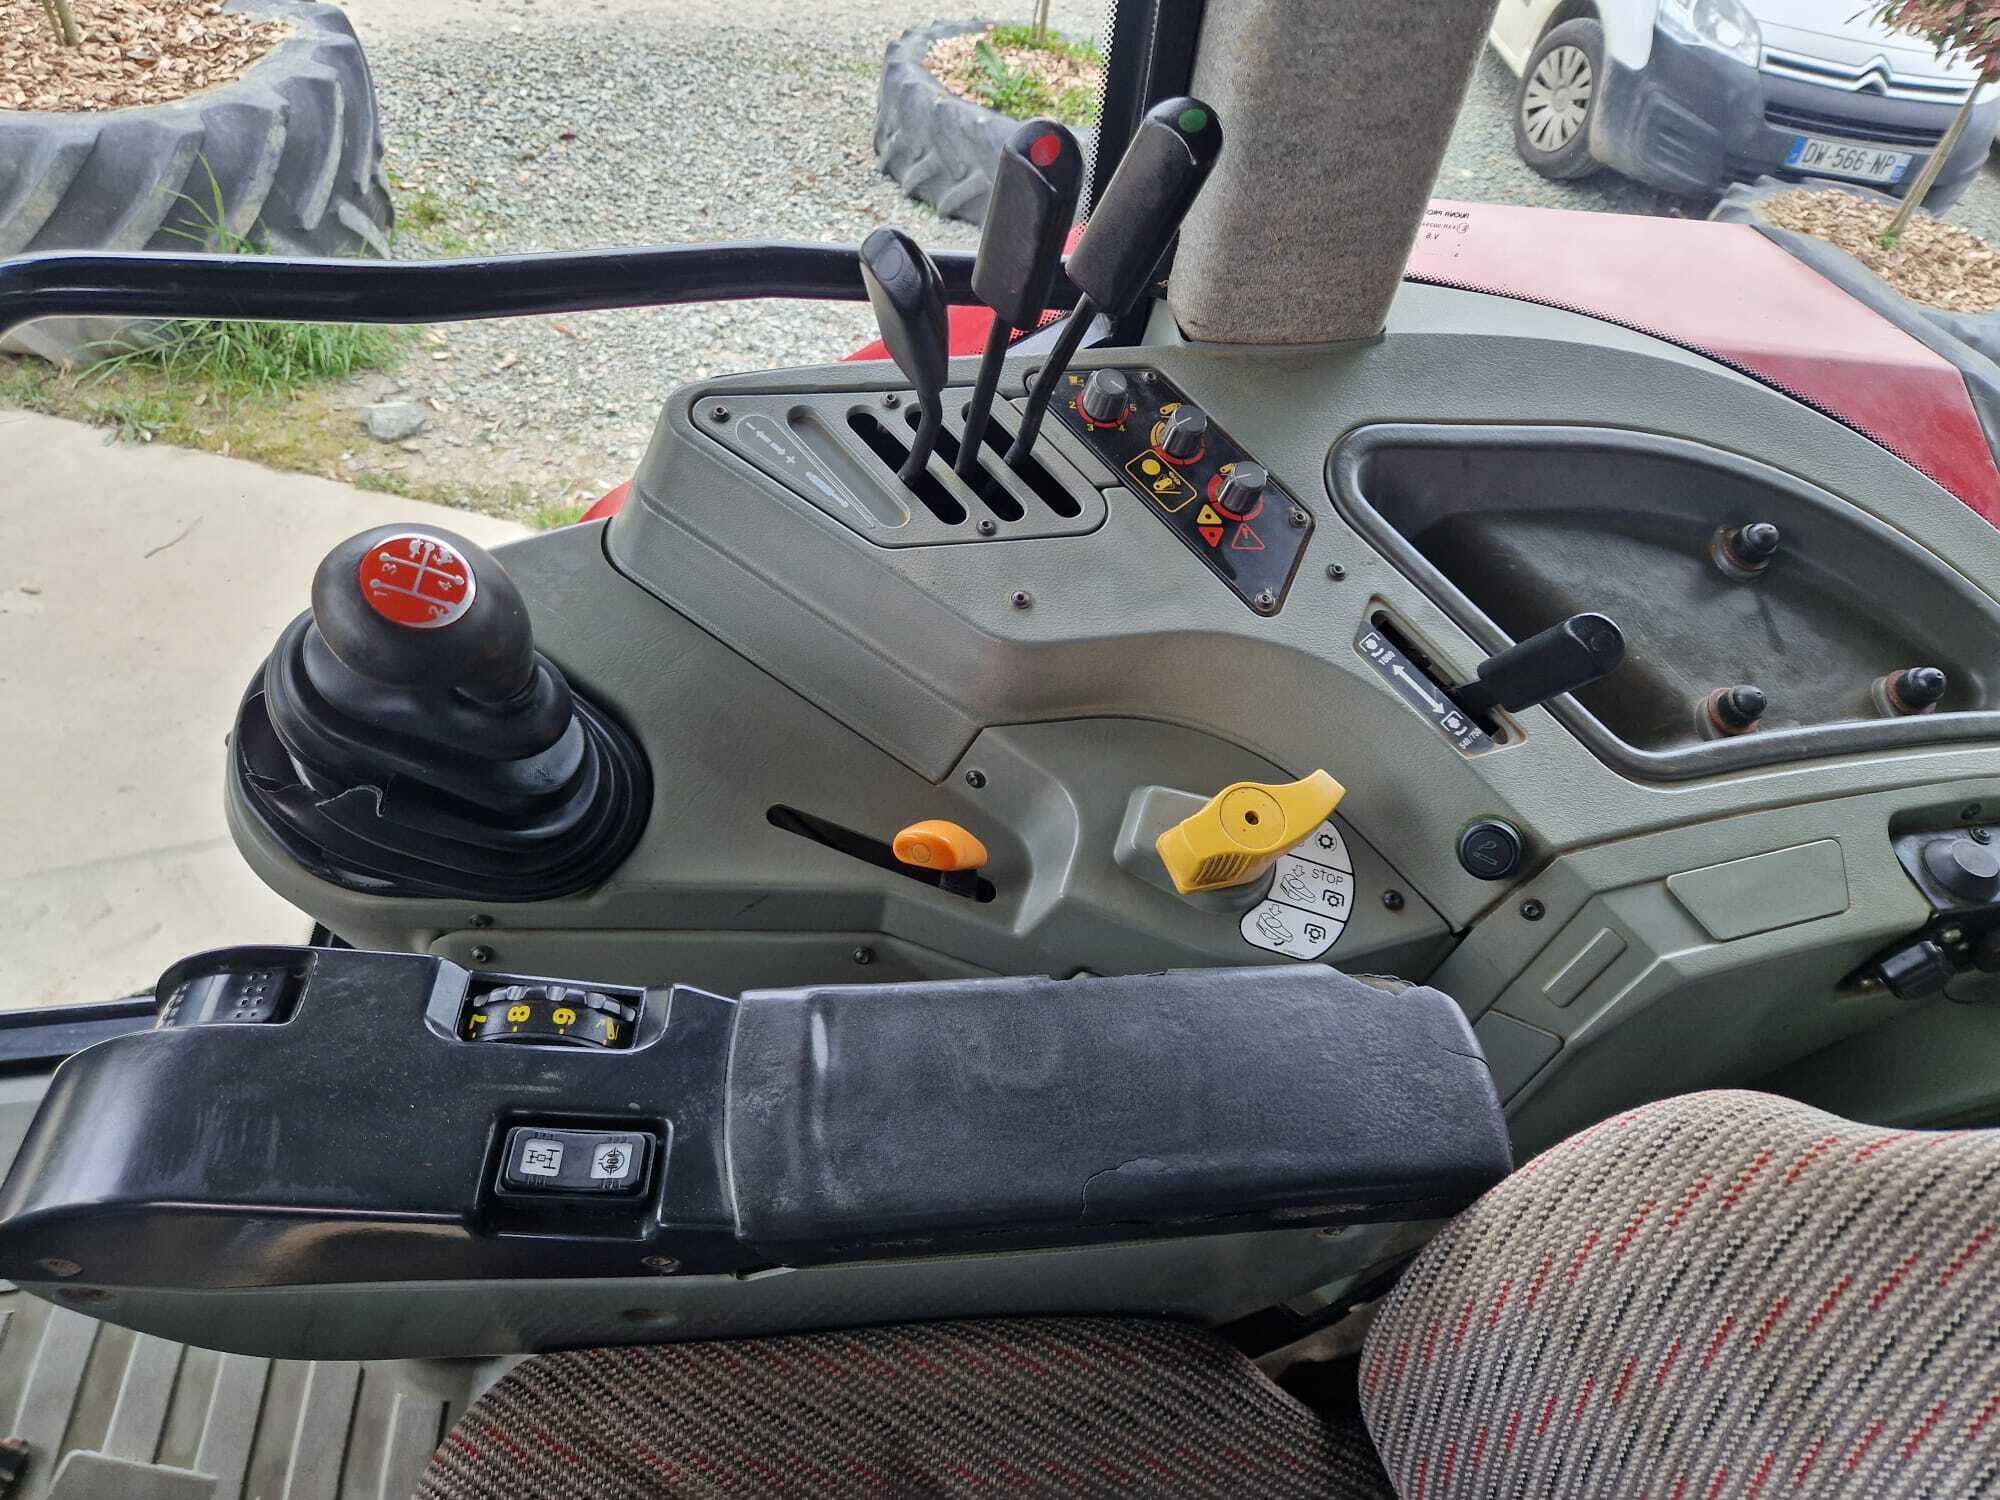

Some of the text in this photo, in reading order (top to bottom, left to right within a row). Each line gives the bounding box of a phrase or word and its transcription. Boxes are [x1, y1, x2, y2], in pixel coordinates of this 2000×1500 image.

[1801, 142, 1896, 175] DW-566-NP
[1068, 401, 1076, 409] 2
[1129, 403, 1137, 411] 5
[1086, 423, 1094, 432] 3
[1119, 424, 1126, 432] 4
[382, 562, 397, 575] 3
[437, 580, 452, 591] 4
[1311, 868, 1343, 885] STOP
[507, 1005, 531, 1023] 8
[552, 1007, 577, 1025] 9
[468, 1014, 487, 1030] 7
